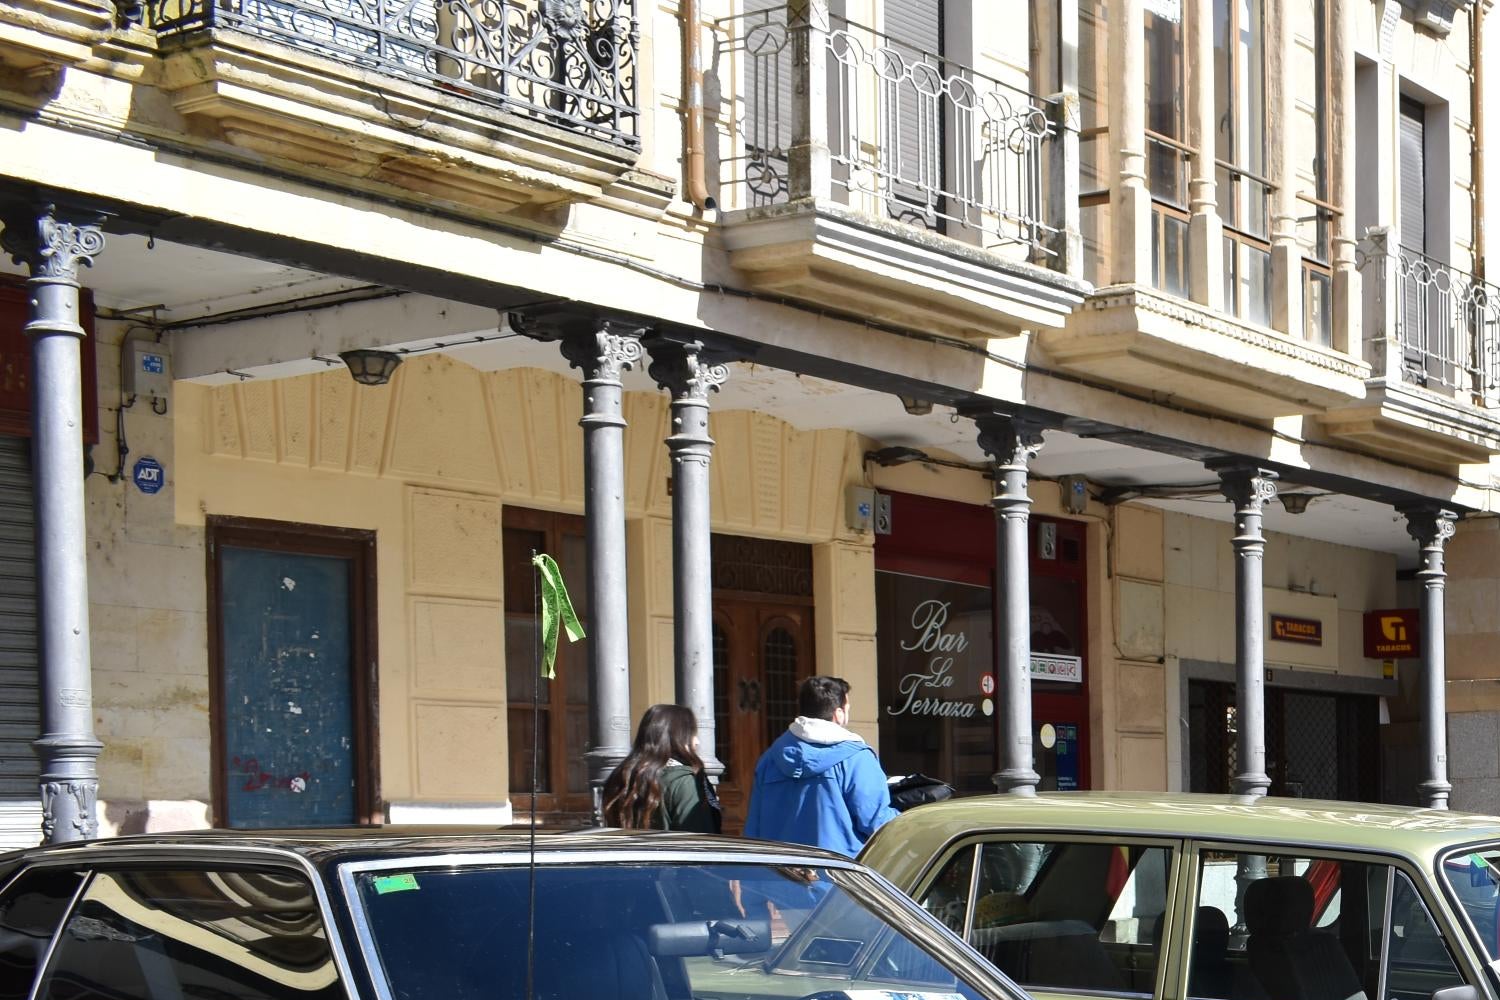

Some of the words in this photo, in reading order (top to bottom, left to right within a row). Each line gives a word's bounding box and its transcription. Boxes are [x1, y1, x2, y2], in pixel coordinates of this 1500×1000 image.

[138, 467, 160, 481] ADT
[901, 600, 968, 652] Bar
[1286, 622, 1316, 634] TABACOS
[1376, 644, 1411, 652] TABACOS
[925, 657, 954, 687] La
[887, 673, 976, 717] Terraza
